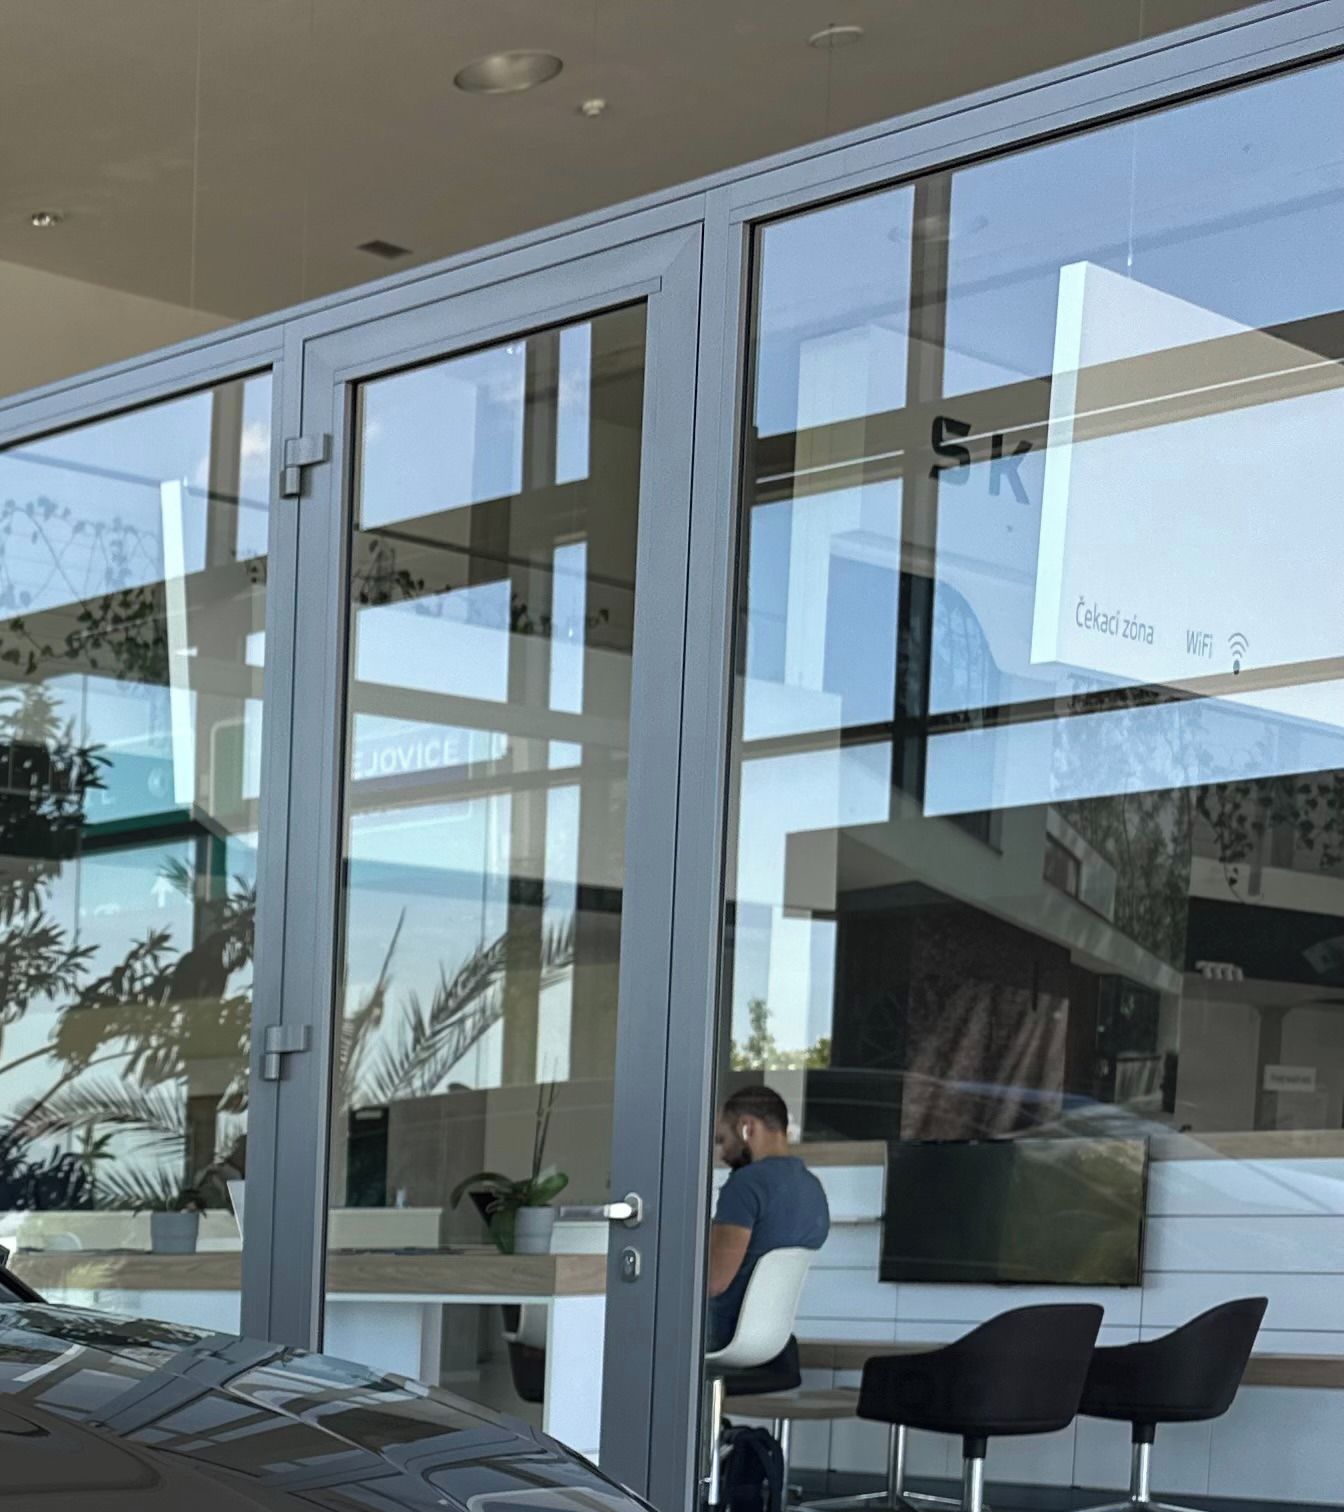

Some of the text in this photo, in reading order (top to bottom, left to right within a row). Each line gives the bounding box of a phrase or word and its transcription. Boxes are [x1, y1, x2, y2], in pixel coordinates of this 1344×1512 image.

[1075, 595, 1155, 646] Čekací zóna
[1186, 629, 1214, 659] WiFi
